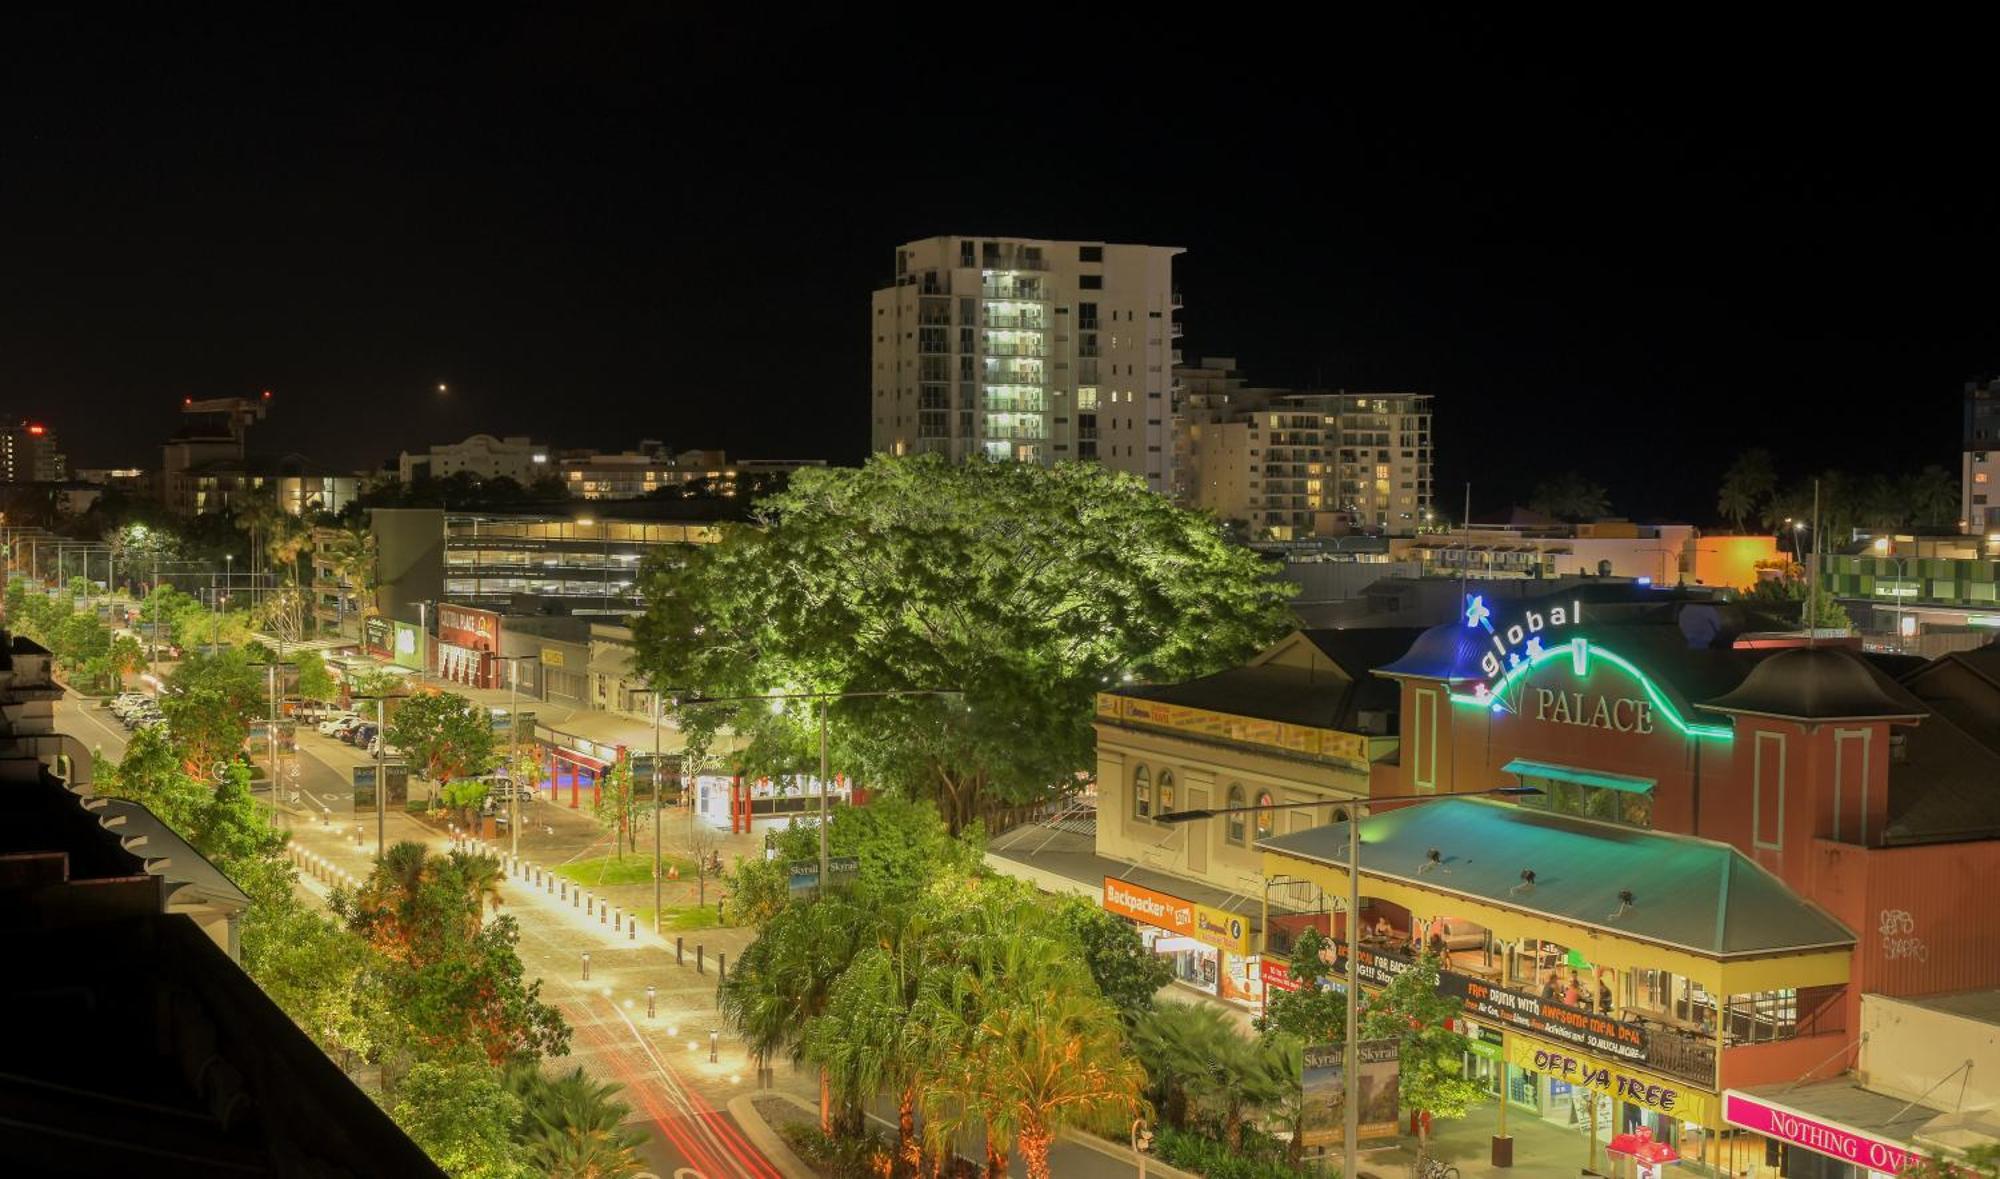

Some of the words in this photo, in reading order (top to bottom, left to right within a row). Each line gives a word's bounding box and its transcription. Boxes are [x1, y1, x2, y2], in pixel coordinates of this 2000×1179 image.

[1482, 601, 1580, 677] global
[1535, 688, 1653, 734] PALACE
[1107, 885, 1165, 917] Backpacker
[1304, 1051, 1342, 1067] Skyrail
[1360, 1046, 1398, 1062] Skyrail
[1534, 1050, 1578, 1079] OFF
[1582, 1063, 1610, 1090] YA
[1616, 1074, 1677, 1111] TREE
[1770, 1109, 1857, 1159] NOTHING
